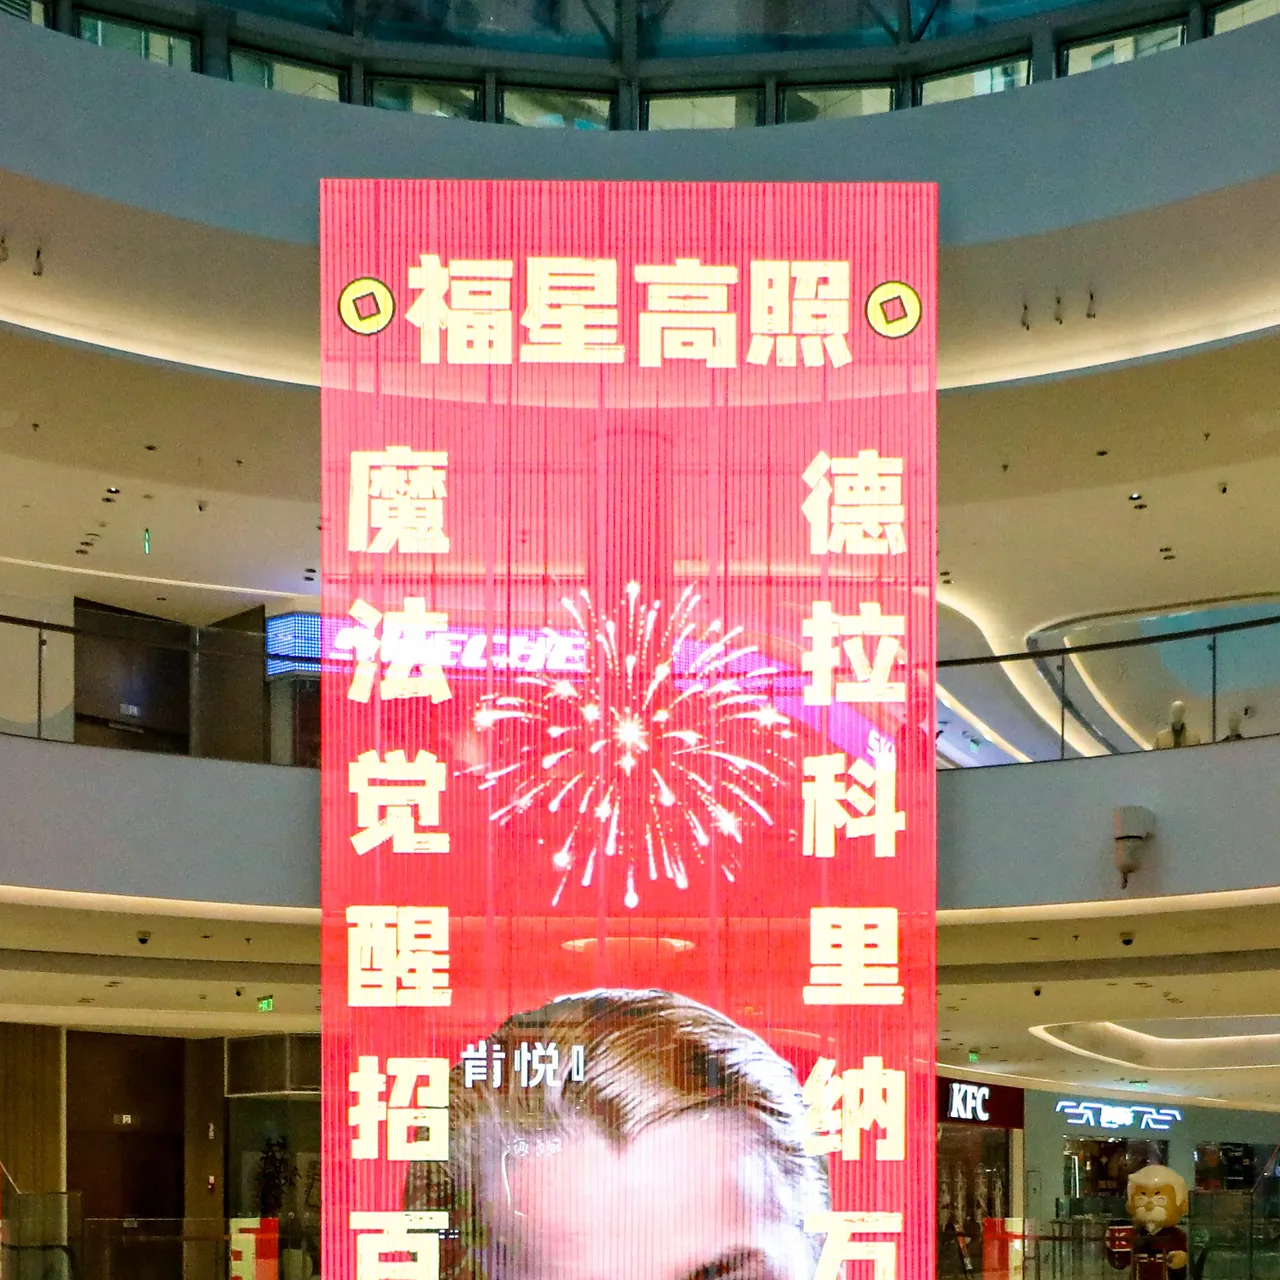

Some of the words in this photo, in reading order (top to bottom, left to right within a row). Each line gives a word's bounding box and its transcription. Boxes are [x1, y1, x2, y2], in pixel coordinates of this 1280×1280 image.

[406, 254, 852, 368] 福星高照
[949, 1083, 989, 1121] KFC
